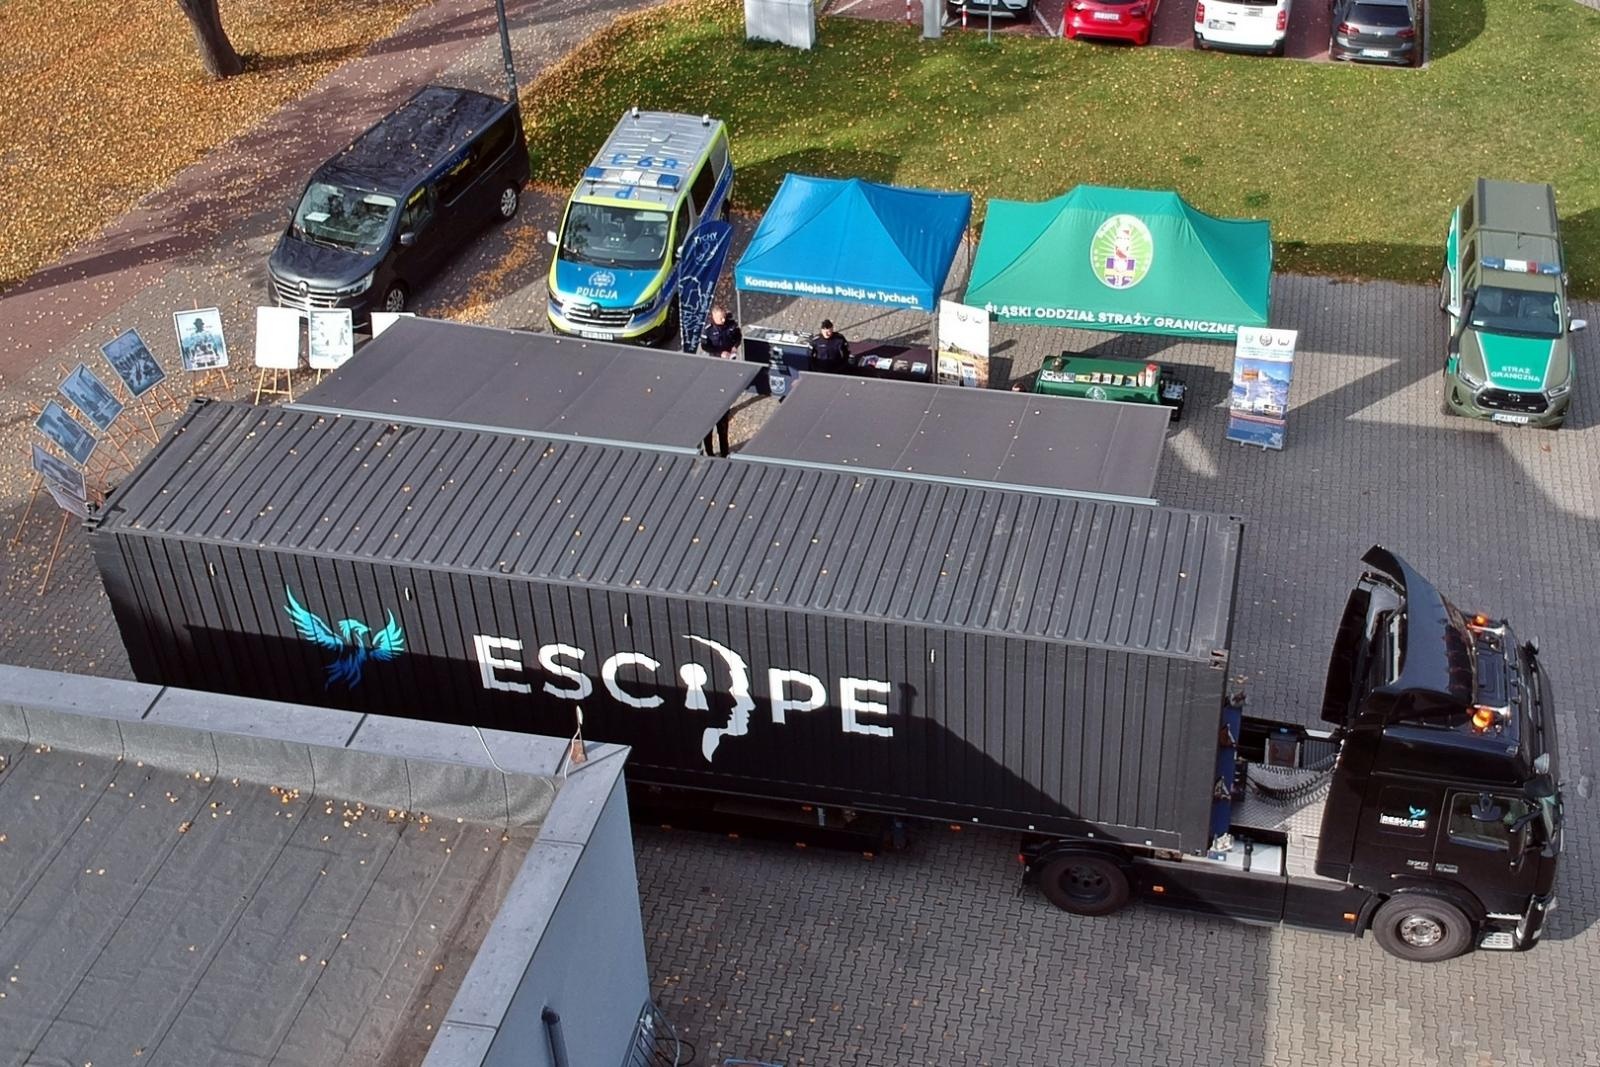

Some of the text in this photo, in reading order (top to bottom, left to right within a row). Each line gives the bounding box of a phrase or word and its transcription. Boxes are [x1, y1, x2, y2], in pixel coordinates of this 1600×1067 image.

[576, 286, 618, 300] POLICJA
[744, 276, 918, 306] Komenda Miejska Policji w Tychach
[984, 301, 1031, 318] ŚLĄSKI
[1034, 307, 1096, 322] ODDZIAŁ
[1098, 311, 1151, 326] STRAŻY
[1490, 371, 1541, 382] GRANICZNA
